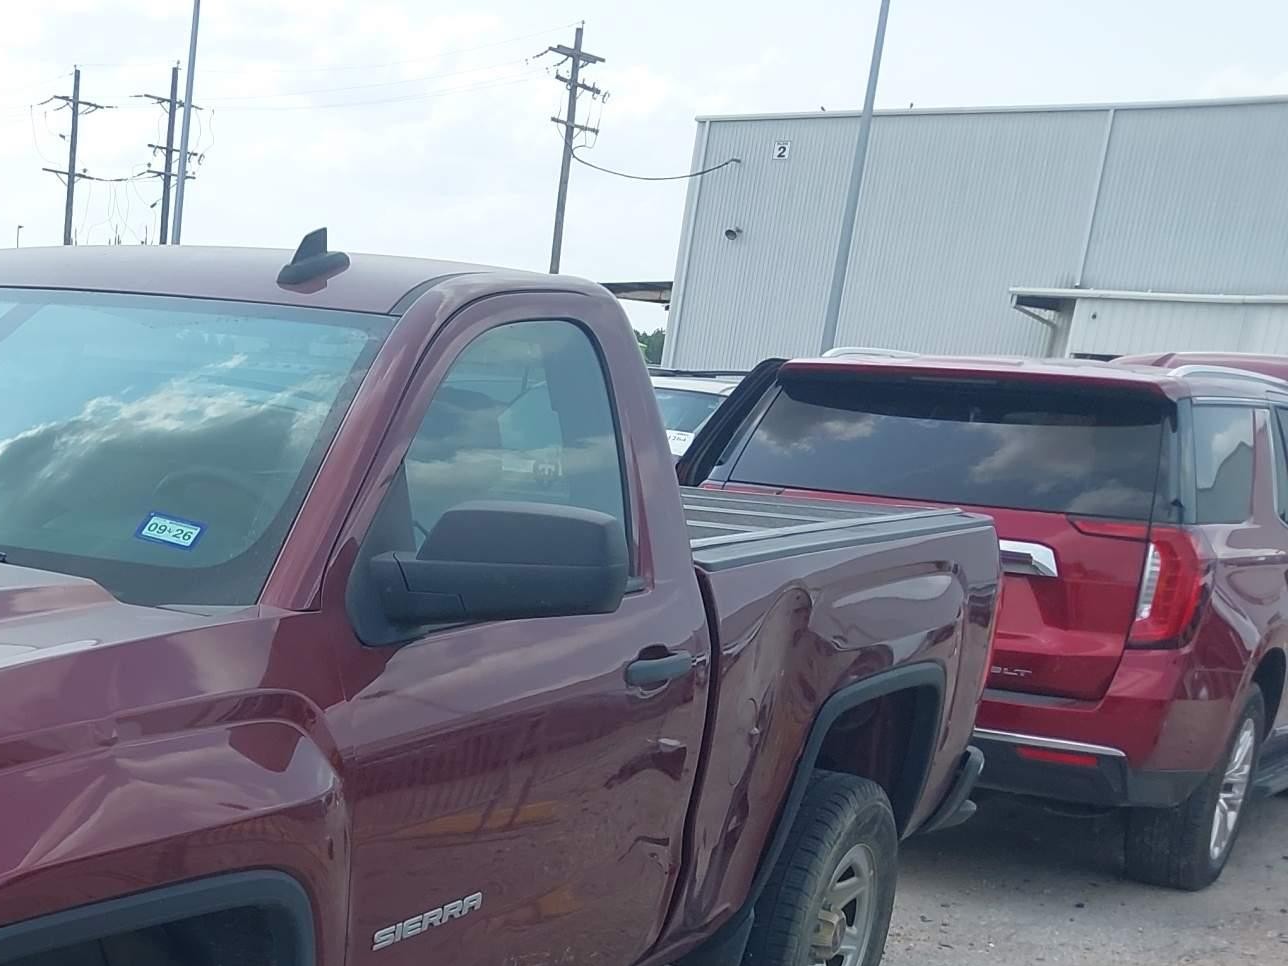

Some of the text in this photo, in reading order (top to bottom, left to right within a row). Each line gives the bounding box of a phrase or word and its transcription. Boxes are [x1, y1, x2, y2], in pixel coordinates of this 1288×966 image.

[777, 145, 787, 158] 2
[147, 522, 193, 541] 09 26
[372, 891, 483, 952] SIERRA
